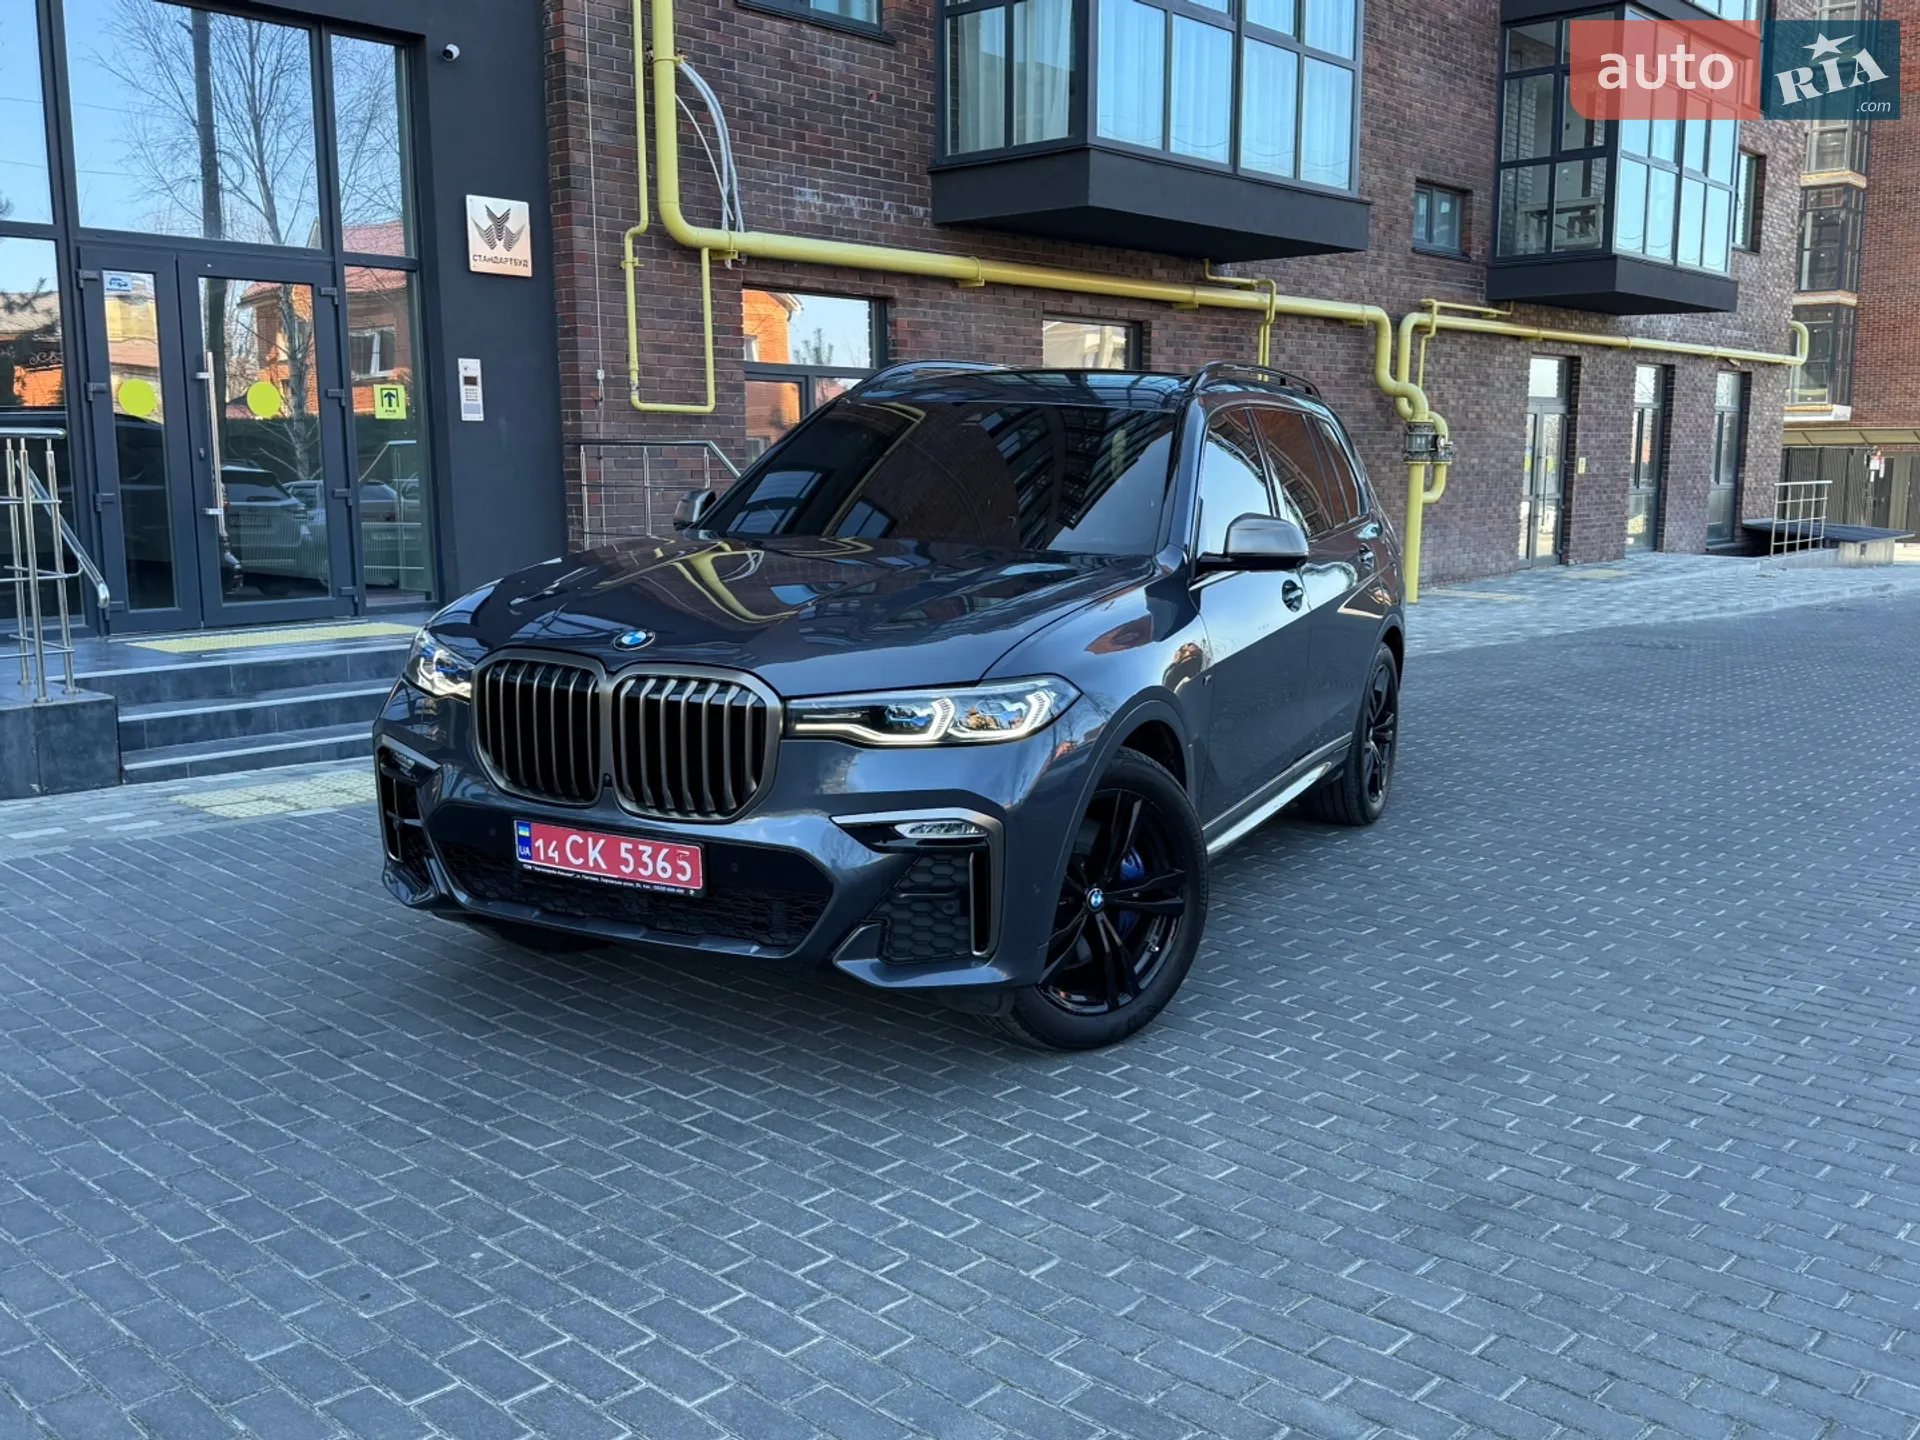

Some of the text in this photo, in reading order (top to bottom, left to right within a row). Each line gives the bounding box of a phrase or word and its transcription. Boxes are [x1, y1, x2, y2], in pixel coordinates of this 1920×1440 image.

[472, 254, 528, 268] СТАНДАРТБУД
[519, 845, 531, 856] UA
[620, 842, 692, 881] 5365
